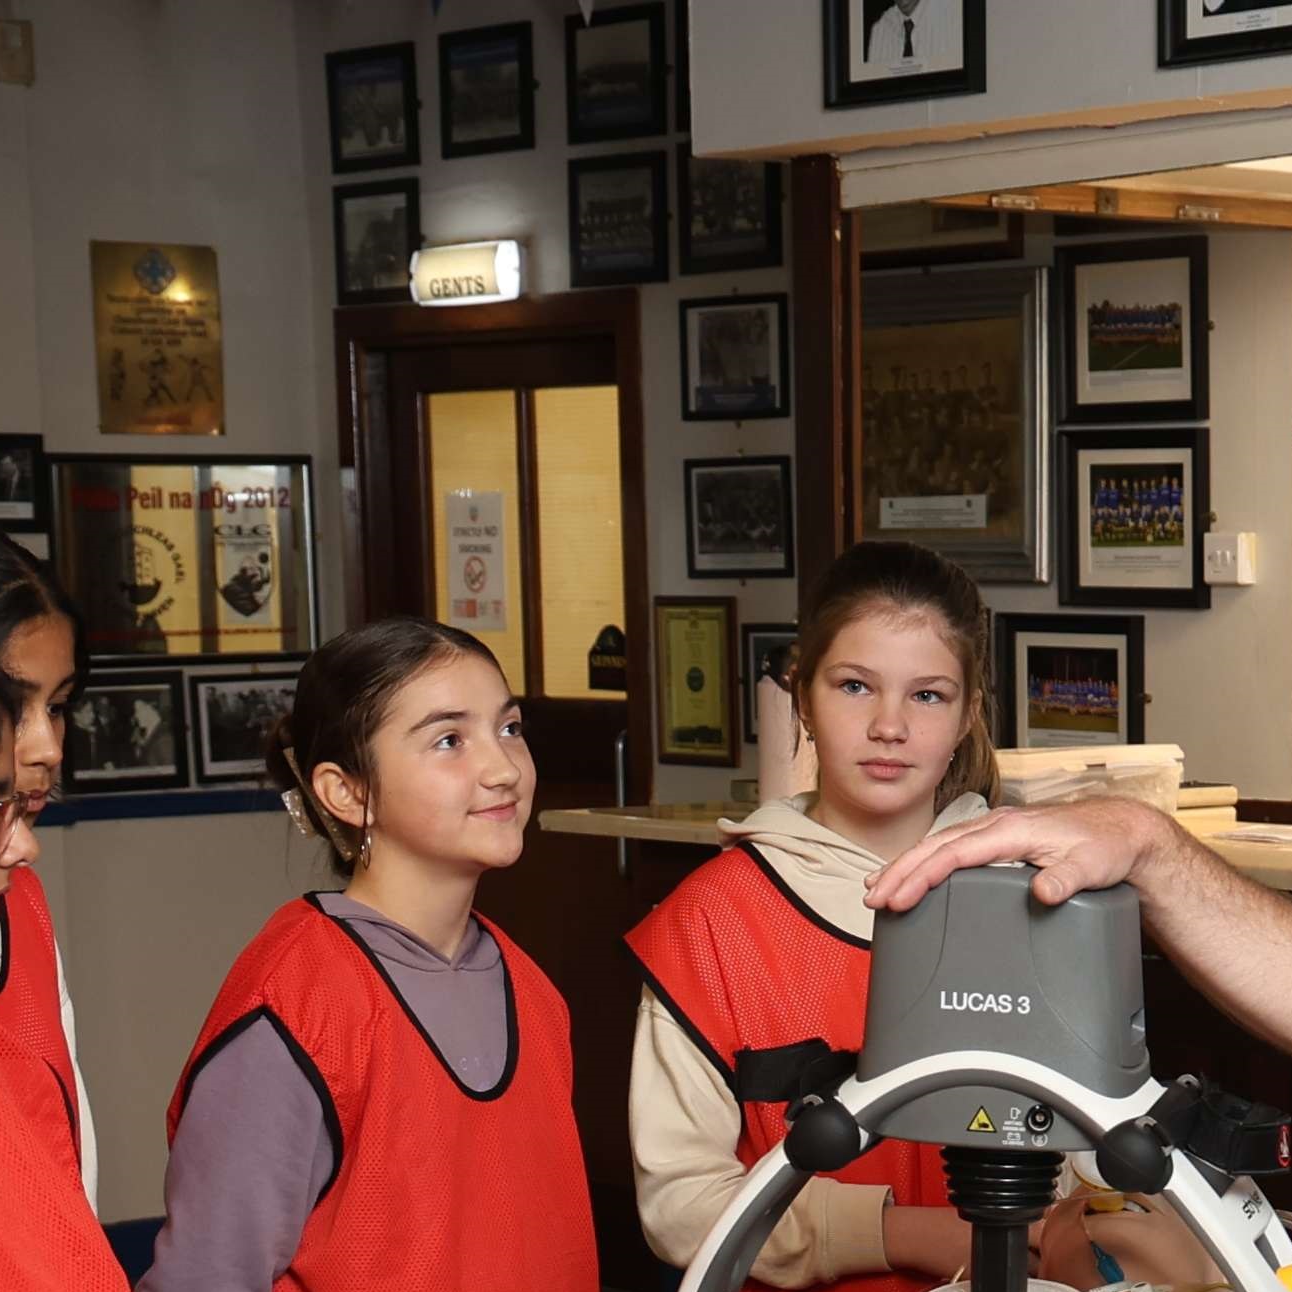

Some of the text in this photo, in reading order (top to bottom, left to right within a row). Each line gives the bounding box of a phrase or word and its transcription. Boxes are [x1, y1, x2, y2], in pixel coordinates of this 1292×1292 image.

[429, 275, 485, 297] GENTS
[127, 486, 163, 509] Peil
[169, 490, 193, 509] na
[243, 487, 291, 509] 2012
[940, 991, 1031, 1014] LUCAS 3
